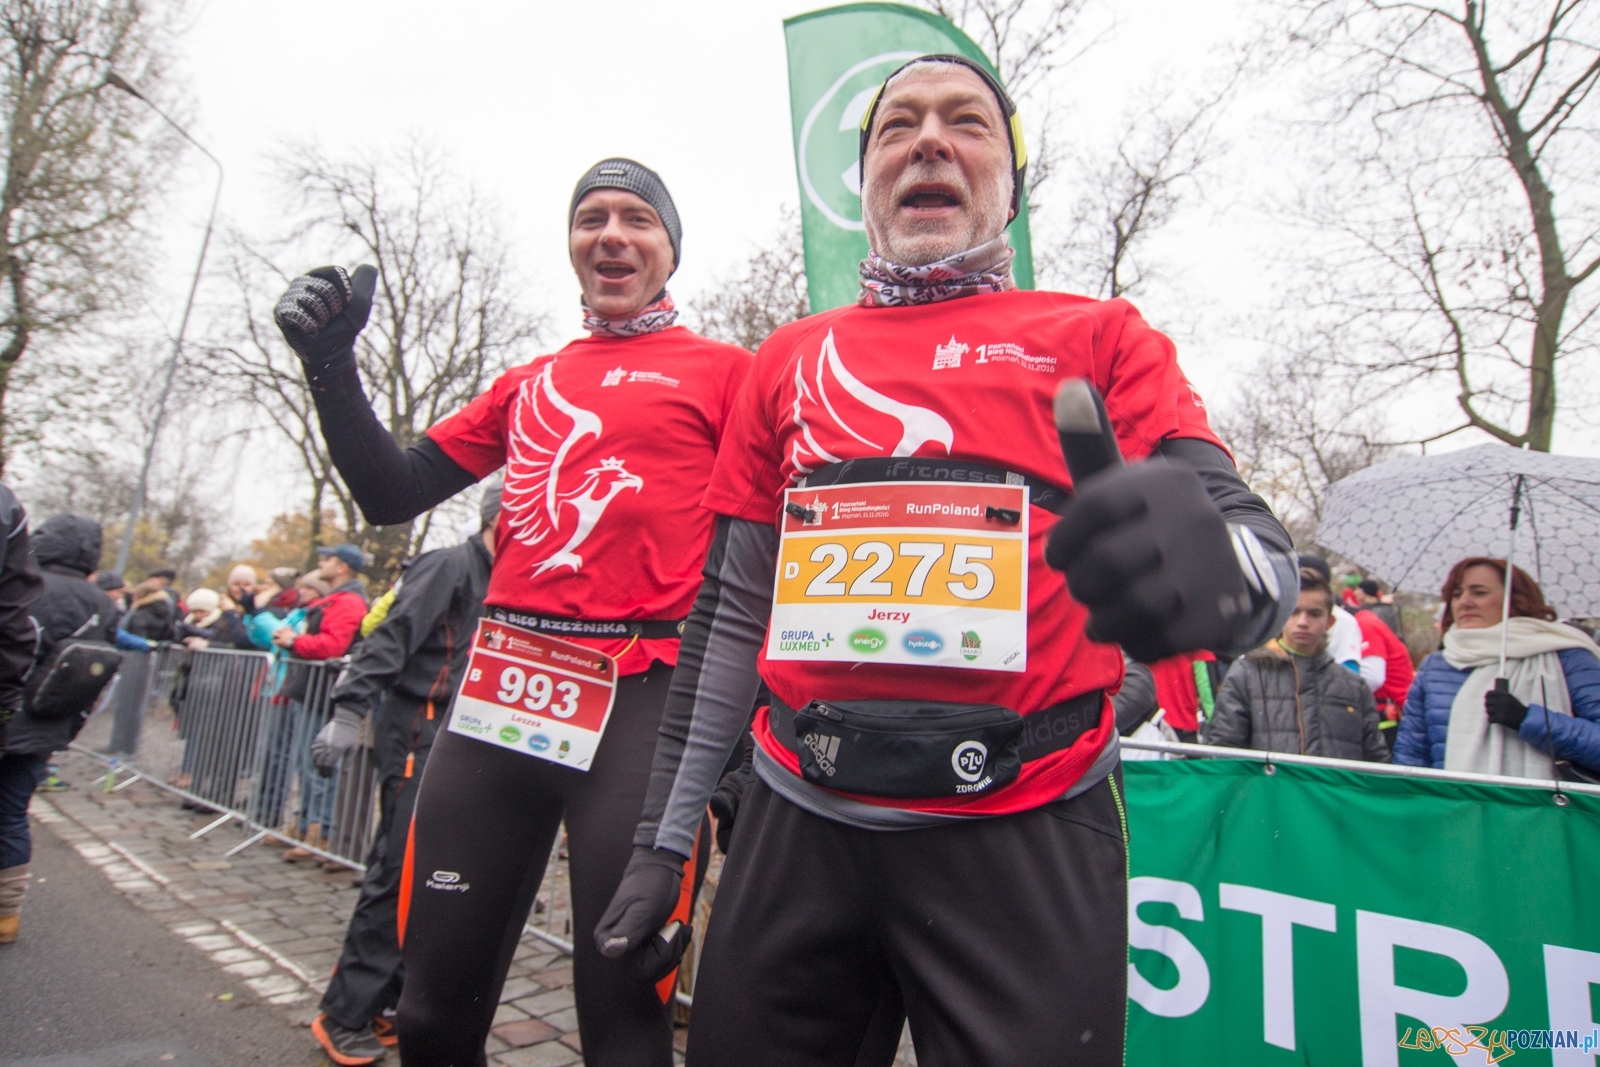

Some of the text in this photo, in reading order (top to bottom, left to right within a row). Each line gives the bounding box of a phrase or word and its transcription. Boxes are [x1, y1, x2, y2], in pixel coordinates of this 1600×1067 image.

[976, 344, 989, 364] 1
[831, 502, 840, 520] 1
[783, 541, 996, 601] D 2275
[868, 609, 910, 623] Jerzy
[781, 630, 815, 641] GRUPA
[853, 637, 885, 649] energy
[780, 641, 821, 651] LUXMED
[469, 665, 582, 719] B 993
[511, 713, 542, 728] Leszek
[803, 732, 836, 778] adidas
[960, 752, 984, 771] PZU
[955, 775, 993, 794] ZDROWIE
